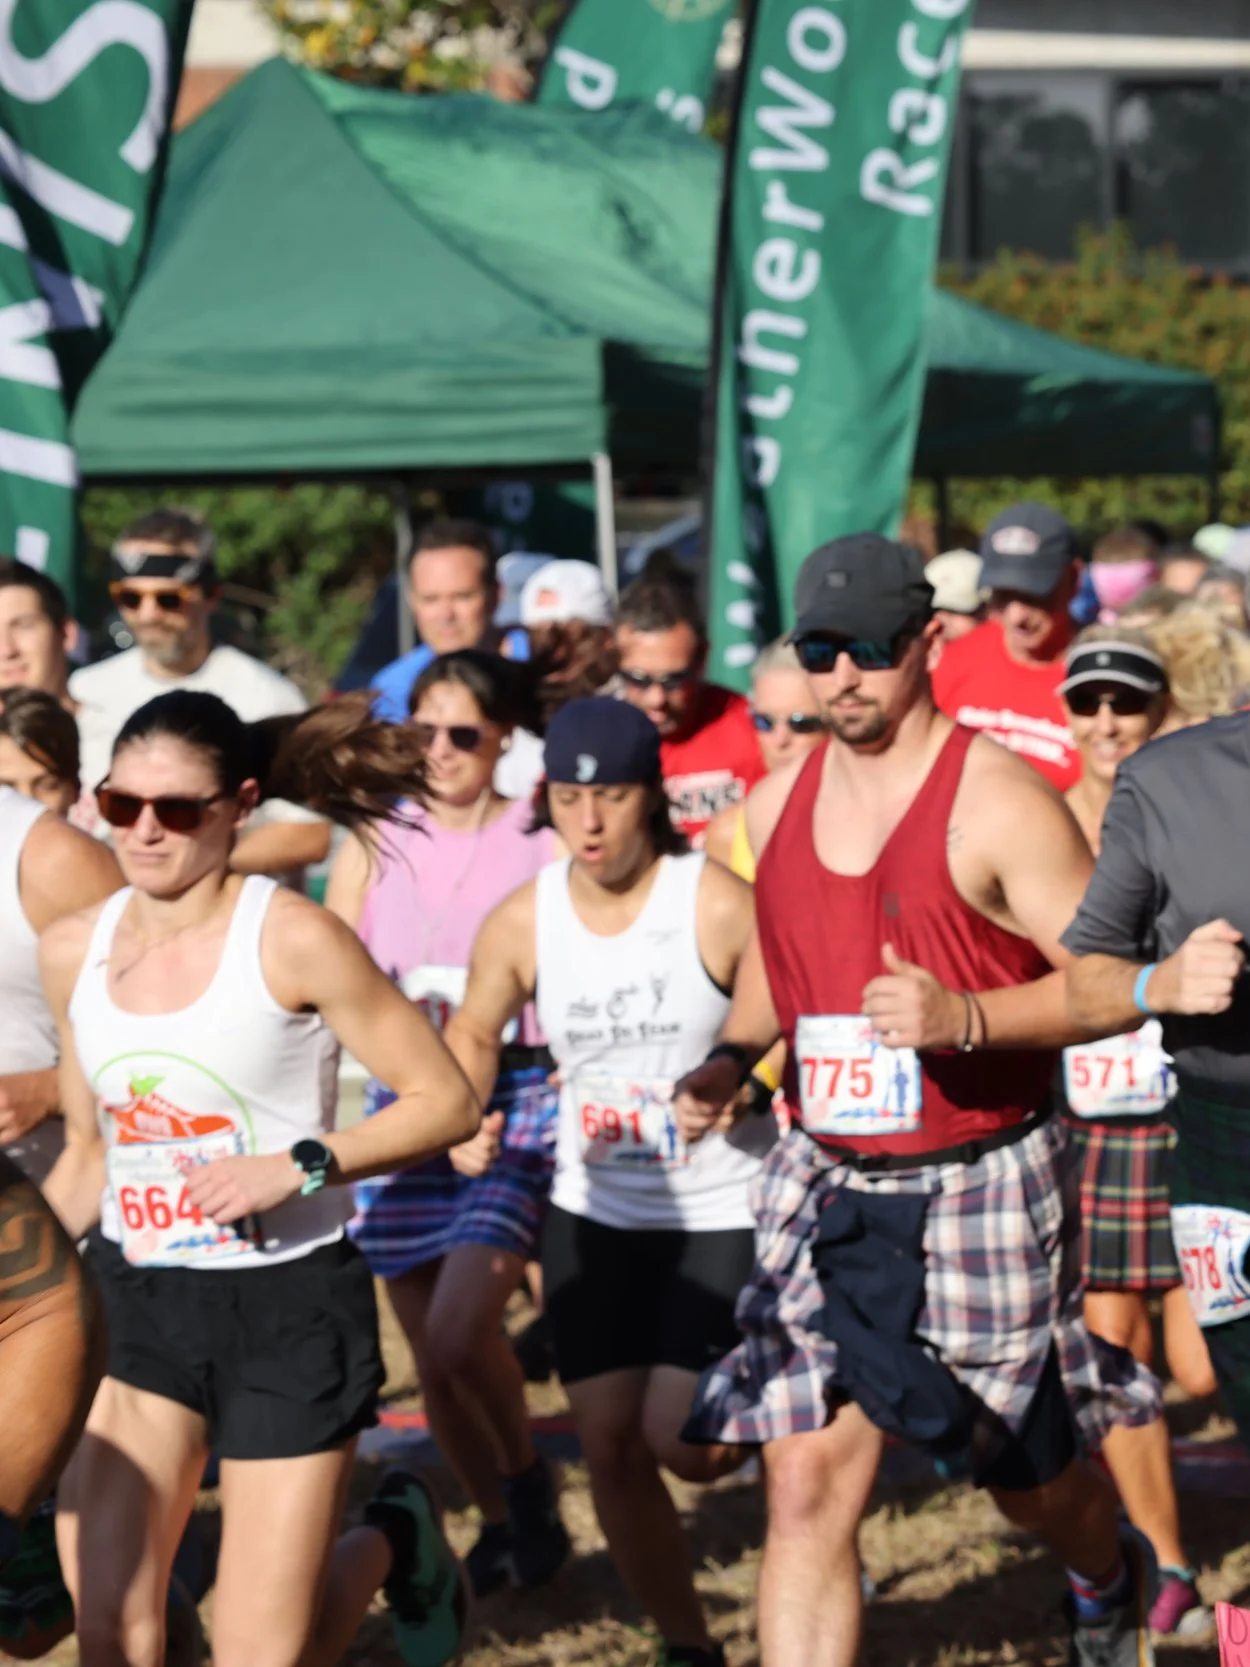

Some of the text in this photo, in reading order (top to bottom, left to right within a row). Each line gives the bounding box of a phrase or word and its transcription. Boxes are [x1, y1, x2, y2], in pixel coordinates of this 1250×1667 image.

[802, 1056, 874, 1099] 775
[1071, 1055, 1136, 1089] 571
[581, 1103, 643, 1145] 691
[119, 1185, 204, 1231] 664
